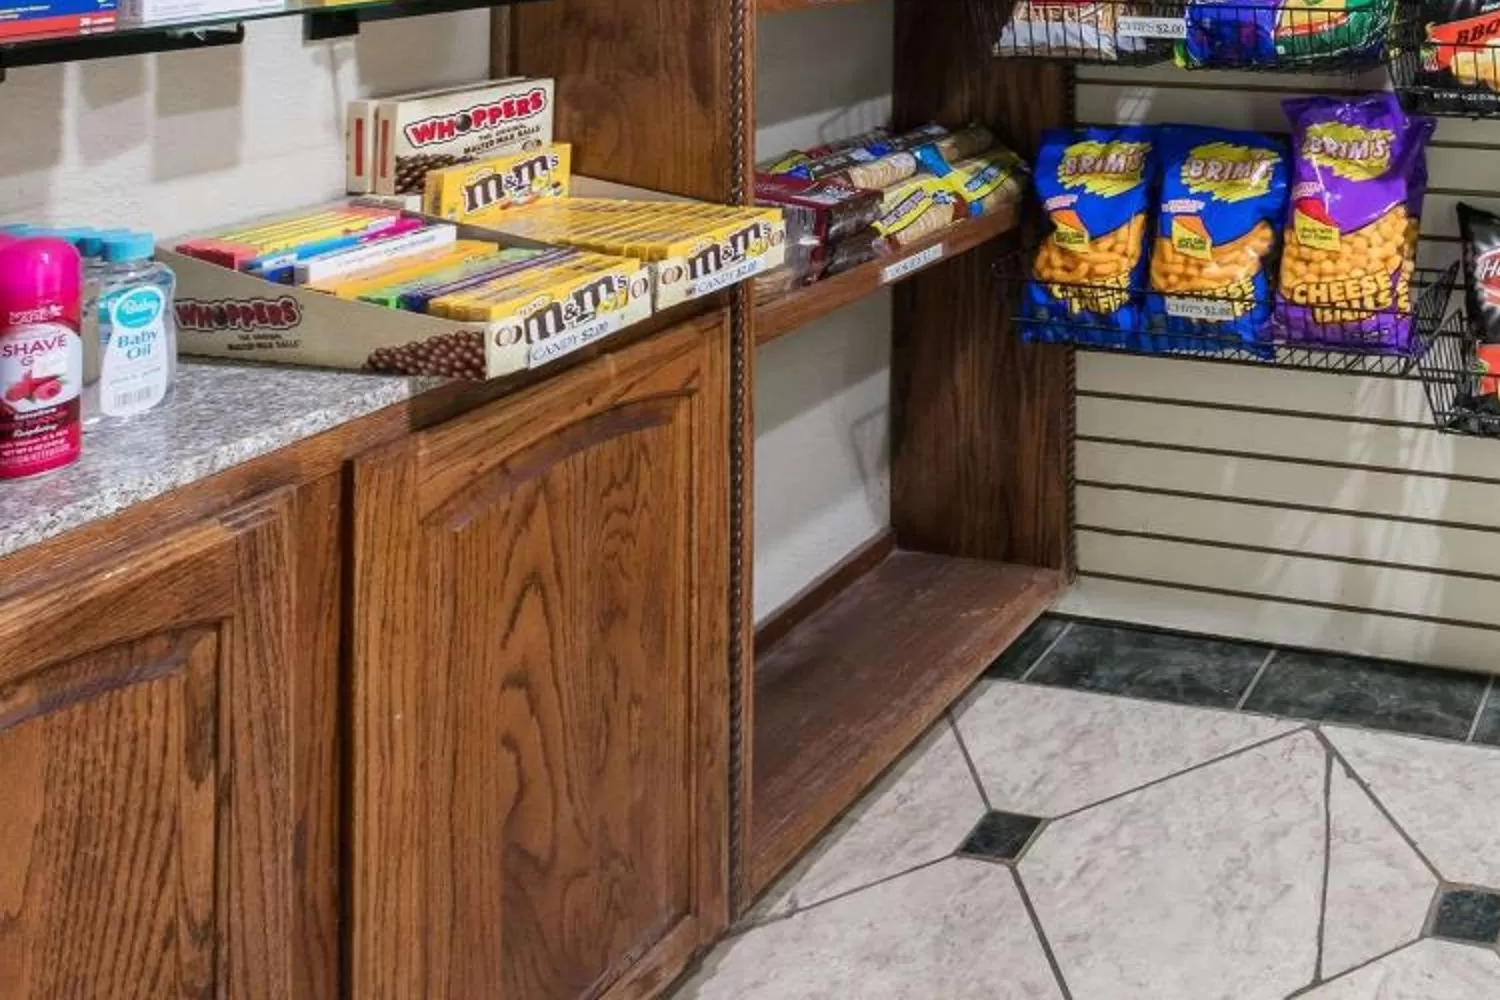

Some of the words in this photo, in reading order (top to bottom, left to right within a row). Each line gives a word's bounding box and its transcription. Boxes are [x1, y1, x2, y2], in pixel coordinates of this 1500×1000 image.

[409, 90, 545, 147] WHOPPERS
[464, 155, 560, 212] m&m's
[687, 221, 772, 280] m&m's
[1293, 270, 1393, 304] CHEESE
[174, 298, 299, 331] WHOPPERS
[524, 274, 628, 344] m&m's
[0, 333, 68, 358] SHAVE
[117, 330, 158, 349] Baby
[126, 347, 151, 361] Oil
